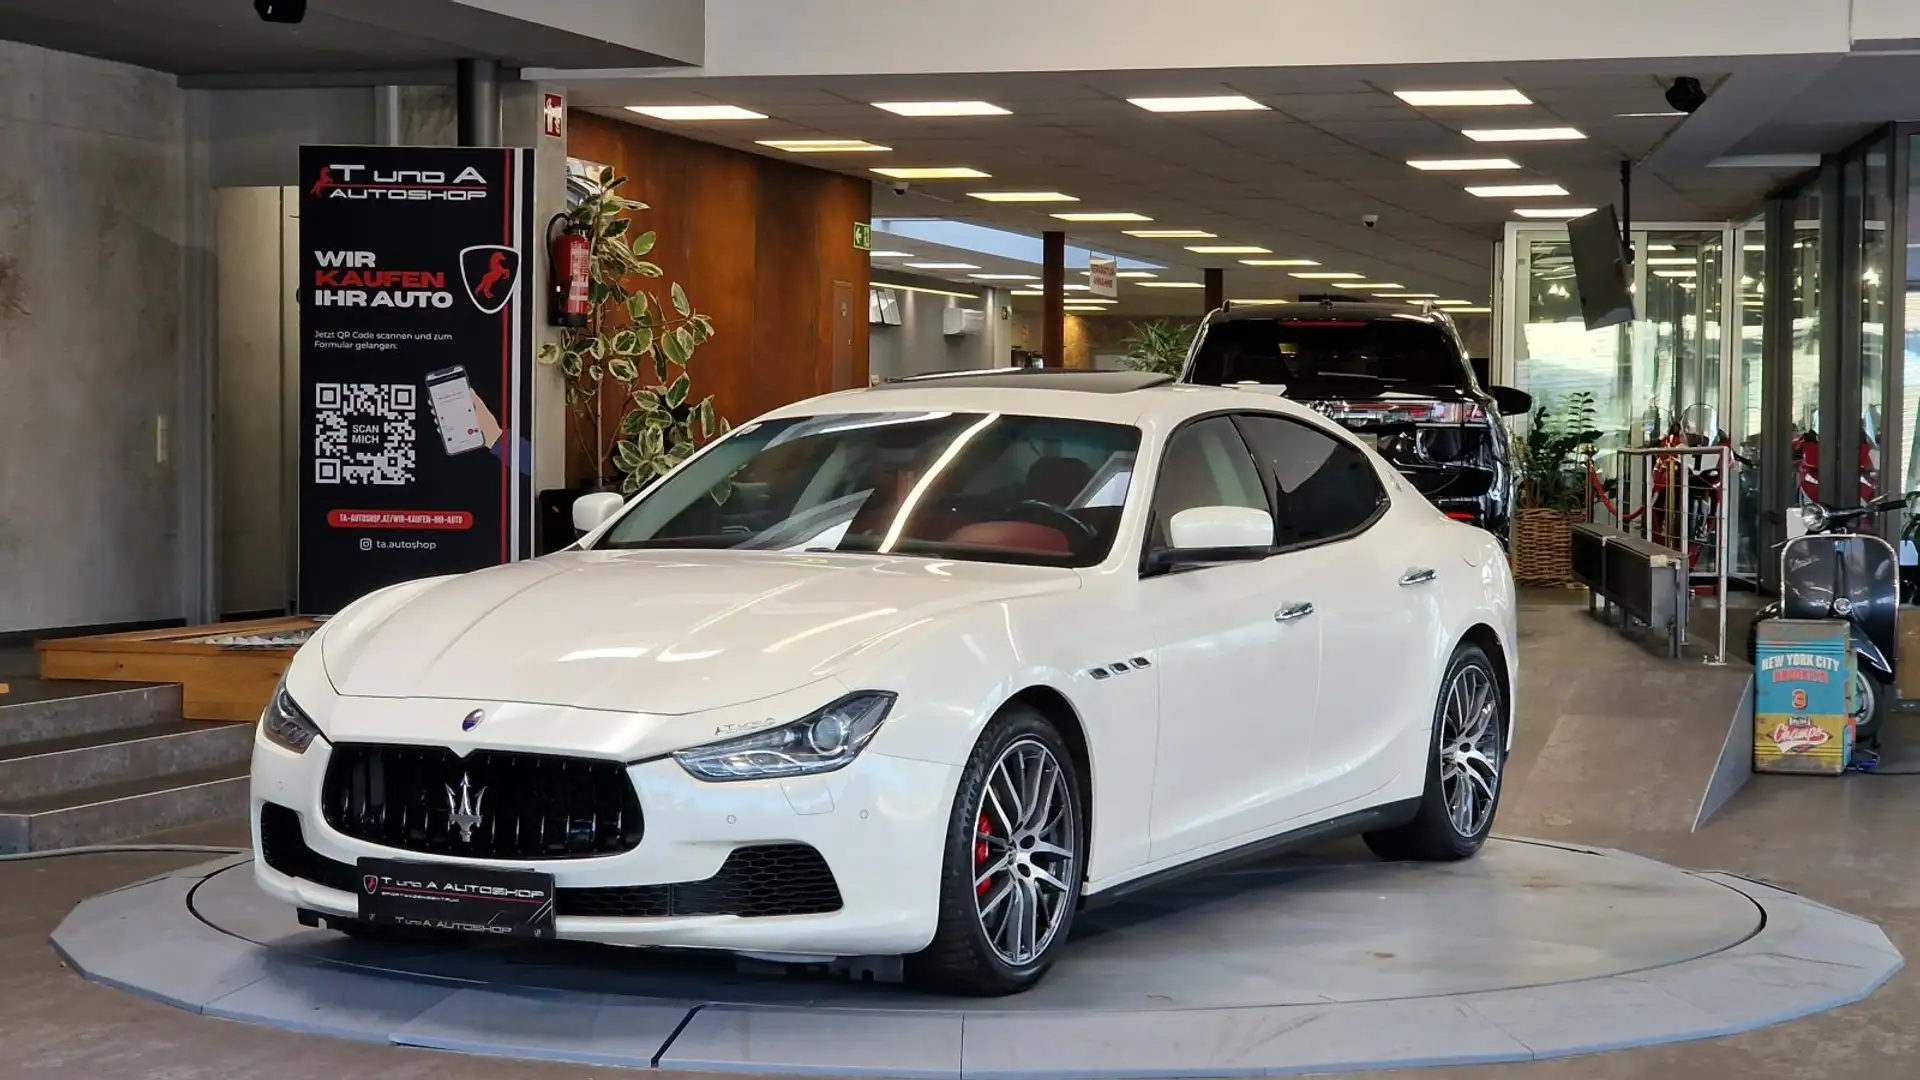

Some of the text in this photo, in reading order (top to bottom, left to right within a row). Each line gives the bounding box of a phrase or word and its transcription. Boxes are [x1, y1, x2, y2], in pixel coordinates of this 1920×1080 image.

[330, 164, 365, 182] T
[453, 166, 487, 184] A
[329, 188, 487, 200] AUTOSHOP
[314, 251, 376, 267] WIR
[314, 270, 445, 288] KAUFEN
[314, 290, 453, 308] IHR AUTO
[314, 331, 453, 341] Jetzt QR Code scannen und zum
[314, 340, 398, 351] Formular gelangen:
[352, 425, 380, 434] SCAN
[351, 434, 380, 444] MICH
[376, 540, 437, 550] ta.autoshop
[1761, 653, 1840, 672] NEW YORK CITY
[1791, 688, 1808, 710] 3
[381, 877, 392, 885] T
[426, 880, 438, 889] A
[443, 883, 545, 898] AUTOSHOP
[436, 921, 512, 934] AUTOSHOP
